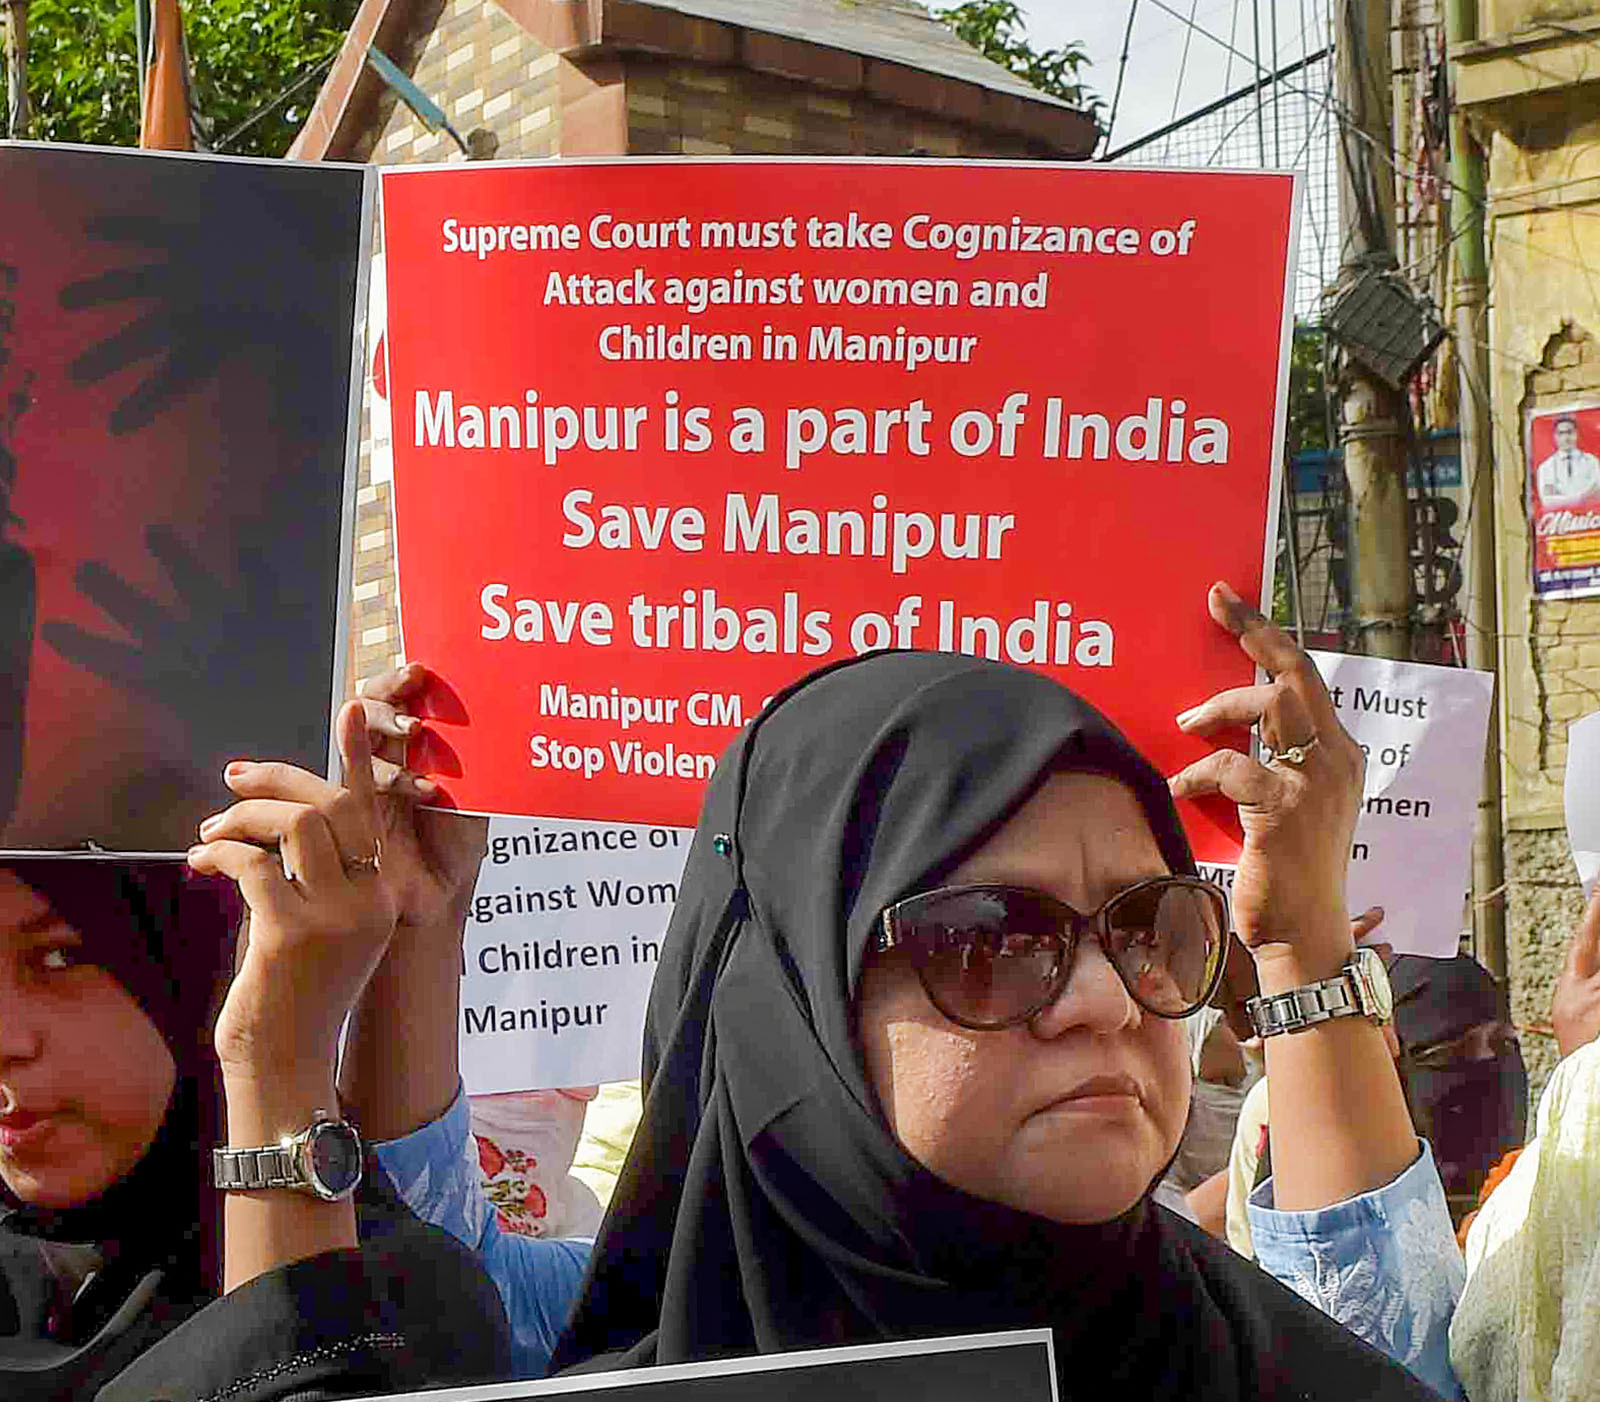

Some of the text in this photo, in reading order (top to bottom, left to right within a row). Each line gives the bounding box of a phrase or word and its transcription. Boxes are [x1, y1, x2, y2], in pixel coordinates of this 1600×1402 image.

[443, 213, 1195, 259] Supreme Court must take Cognizance of
[544, 269, 1047, 313] Attack against women and
[600, 325, 977, 370] Children in Manipur
[415, 390, 1228, 469] Manipur is a part of India
[563, 490, 1014, 573] Save Manipur
[481, 584, 1113, 666] Save tribals of India
[541, 685, 752, 728] Manipur CM.
[1353, 686, 1428, 719] Must
[531, 736, 715, 779] Stop Violen
[1380, 743, 1411, 768] of
[1366, 796, 1431, 818] men
[491, 826, 638, 864] gnizance
[466, 878, 678, 923] gainst Wom
[478, 938, 621, 974] Children
[631, 935, 660, 964] in
[463, 1000, 608, 1035] Manipur
